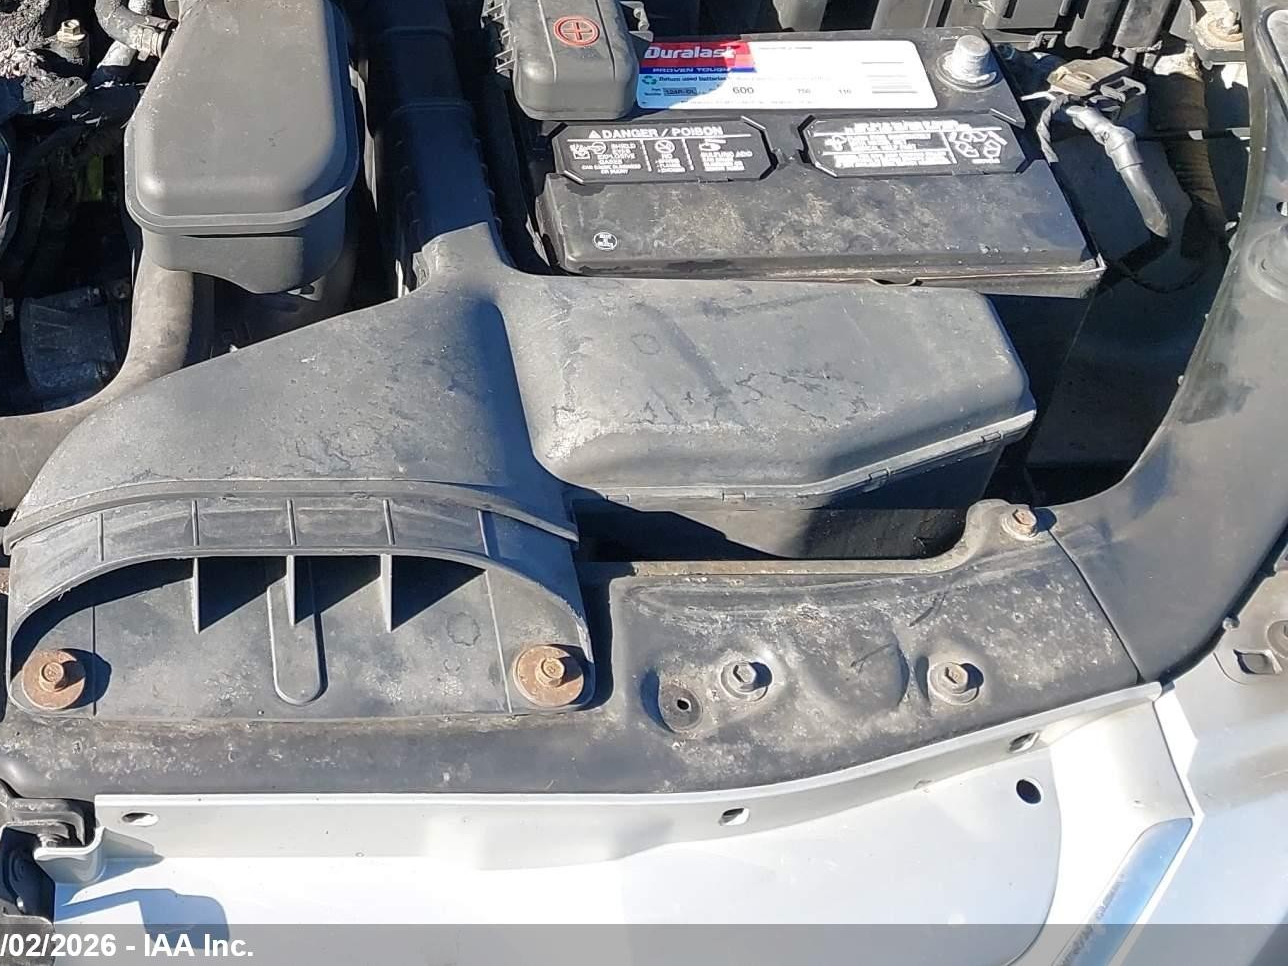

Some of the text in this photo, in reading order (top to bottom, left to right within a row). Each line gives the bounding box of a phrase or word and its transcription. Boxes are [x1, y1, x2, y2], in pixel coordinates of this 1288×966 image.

[644, 46, 737, 60] Duralast
[732, 86, 755, 95] 600
[602, 128, 659, 139] DANGER
[671, 126, 724, 137] POISON
